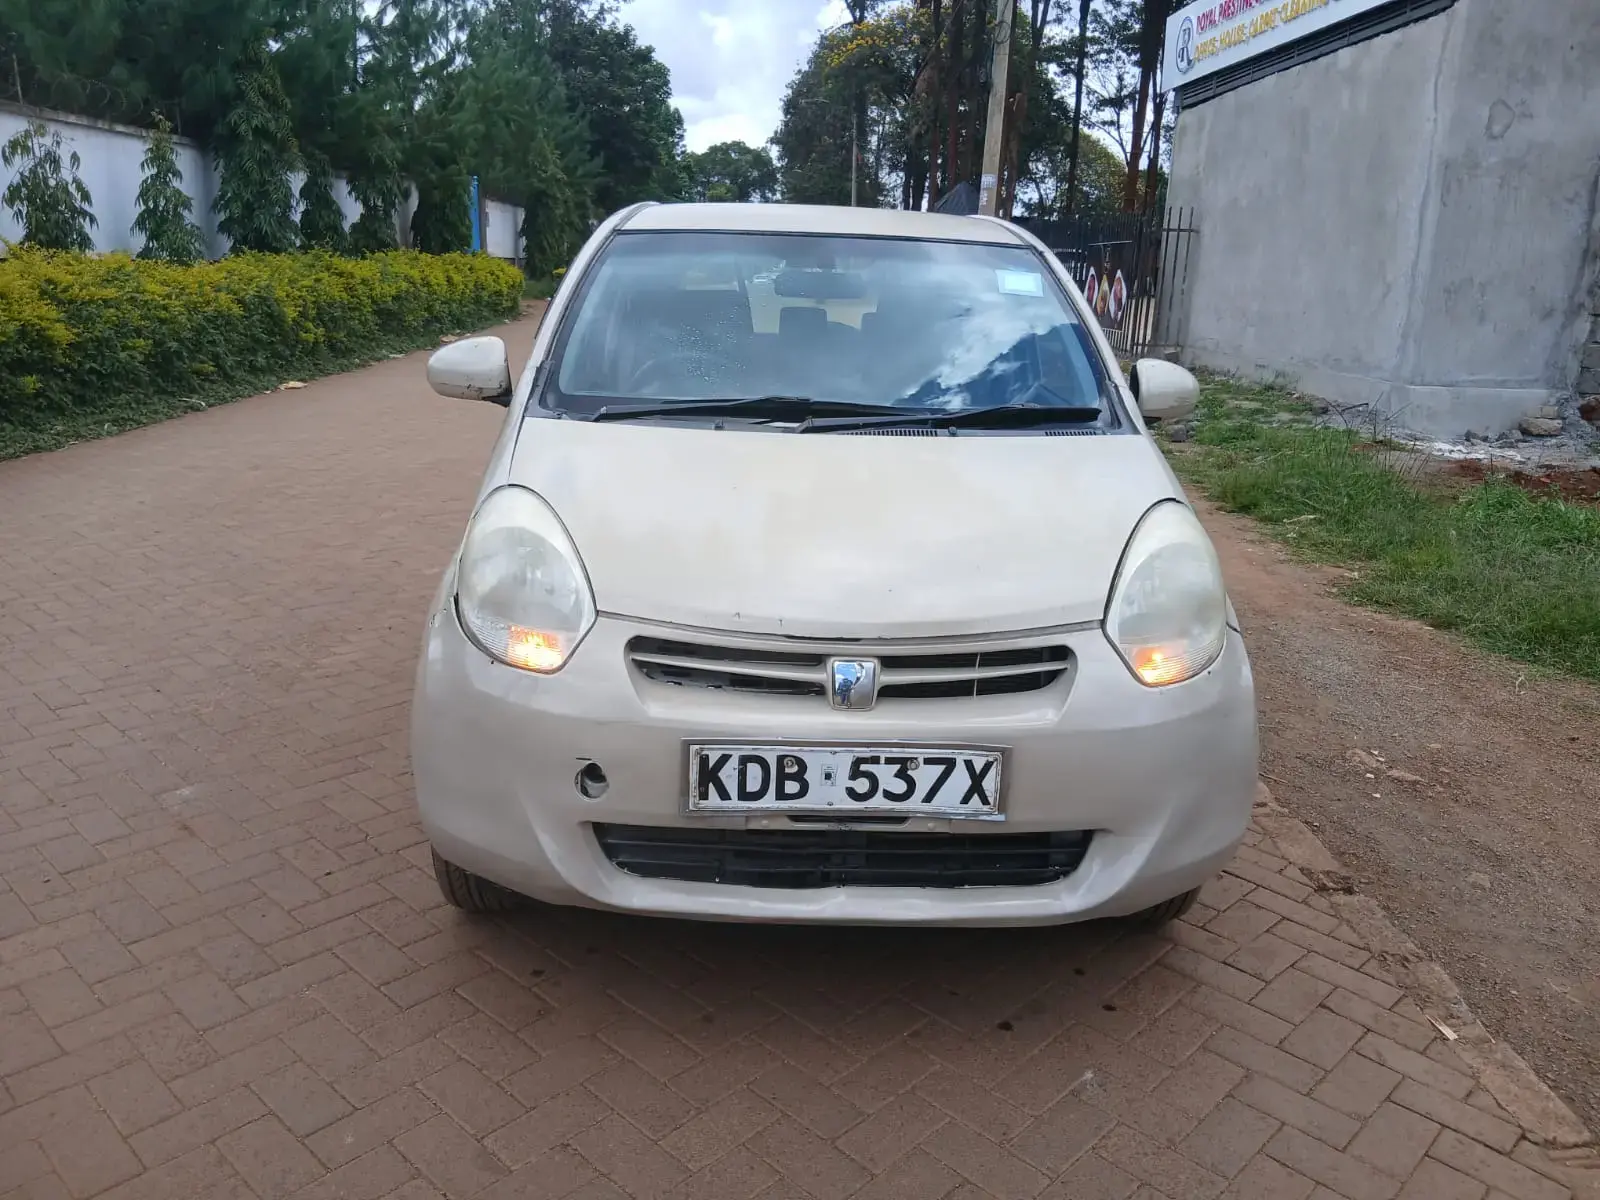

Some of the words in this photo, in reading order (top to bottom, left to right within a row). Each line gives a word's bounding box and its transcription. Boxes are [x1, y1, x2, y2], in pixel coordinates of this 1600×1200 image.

[1196, 7, 1217, 33] ROYAL
[698, 754, 810, 801] KDB
[845, 756, 996, 806] 537X
